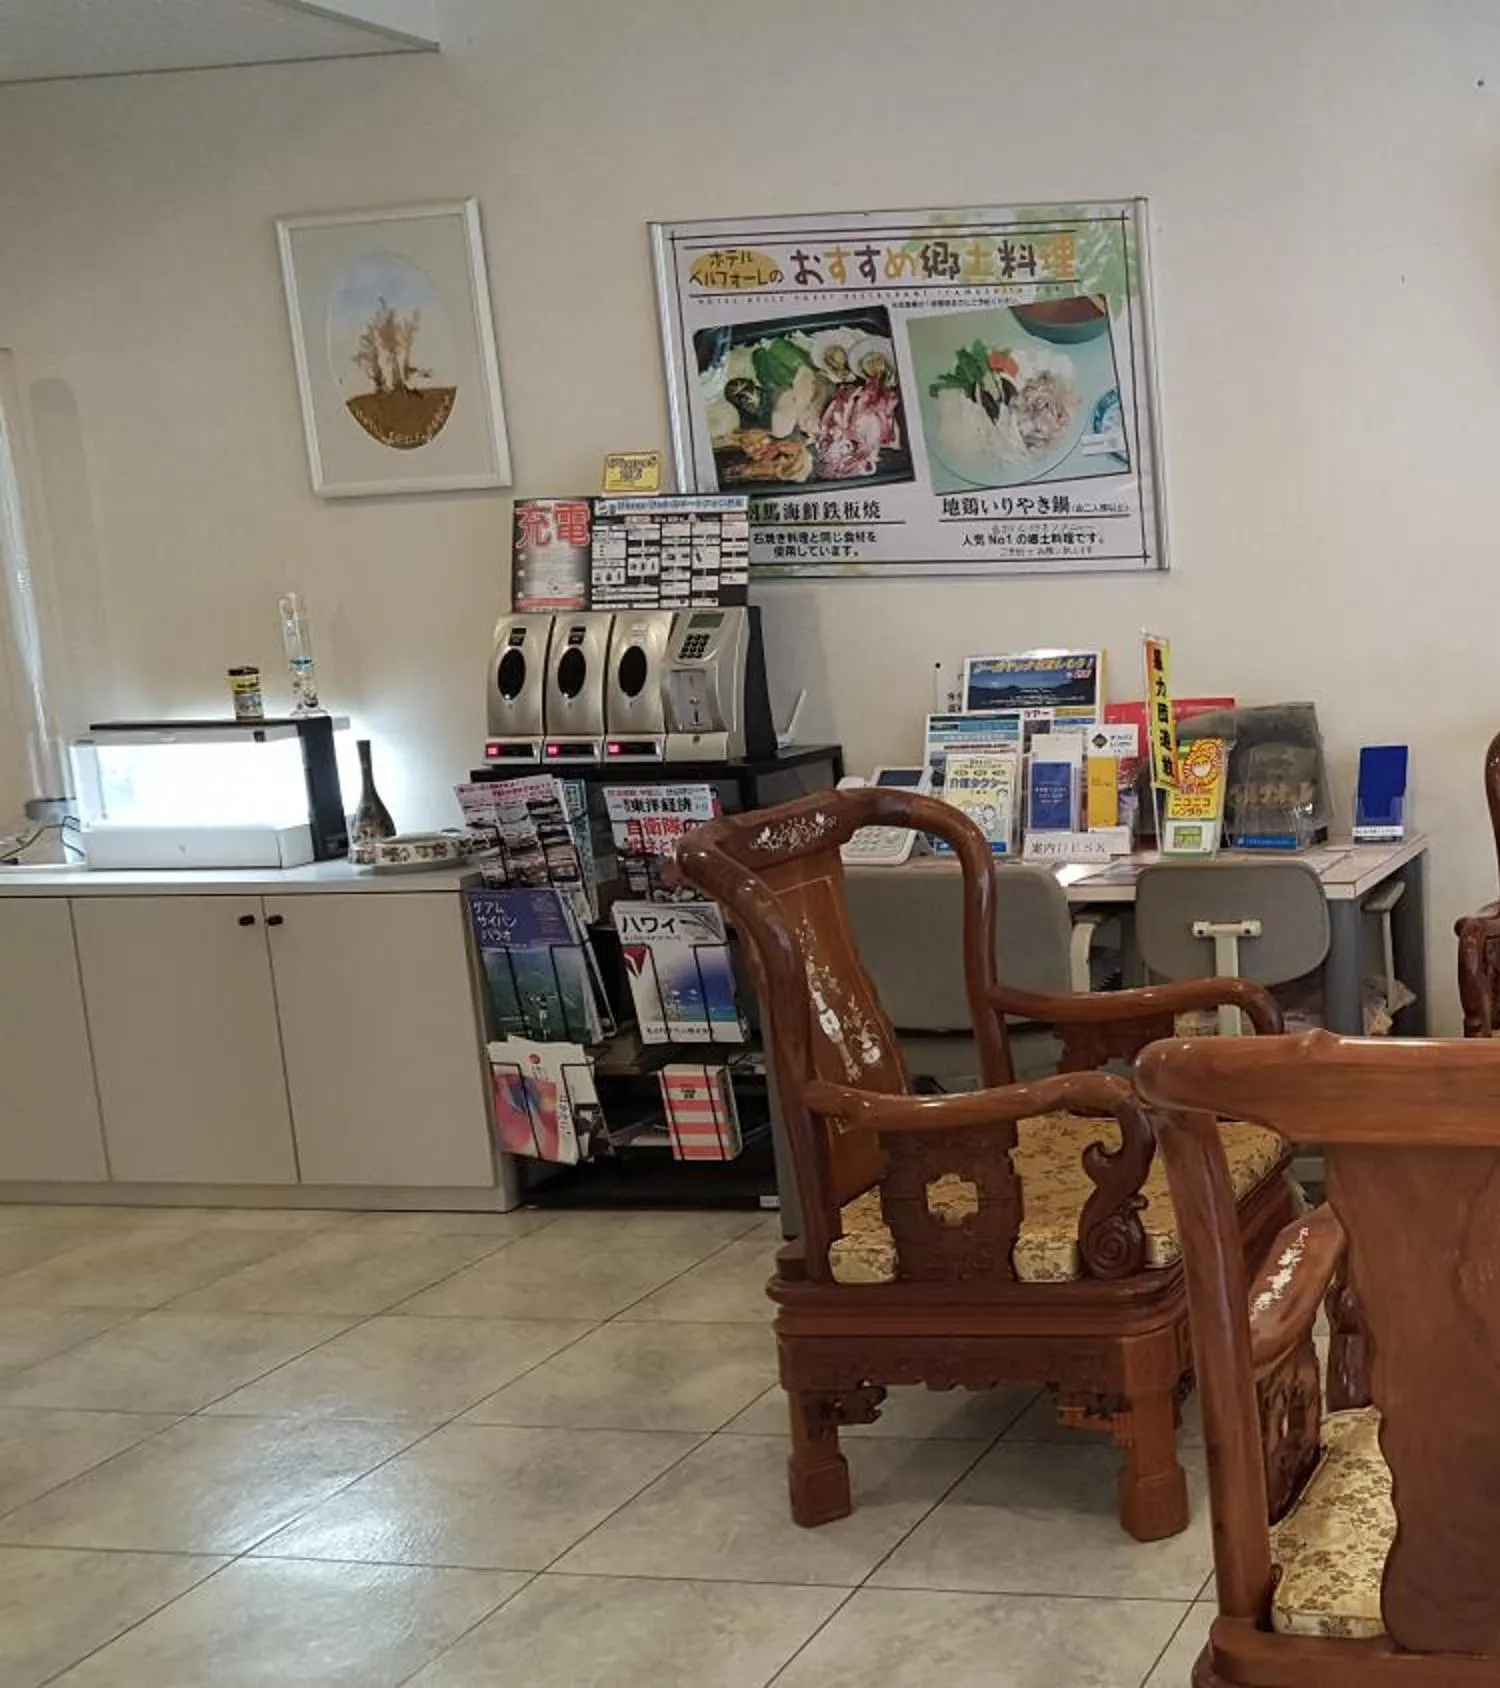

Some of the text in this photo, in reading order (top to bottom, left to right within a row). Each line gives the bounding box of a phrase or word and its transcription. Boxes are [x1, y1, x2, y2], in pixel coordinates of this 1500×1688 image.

[708, 250, 754, 268] ホテル
[789, 233, 1077, 287] おすすめ郷土料理
[943, 495, 1070, 516] 地鶏いりやき鍋
[515, 501, 591, 548] 充電
[753, 532, 877, 545] 石焼き料理と同じ食材を
[773, 546, 860, 558] 使用しています。
[1172, 797, 1211, 807] ニコニコ
[622, 916, 676, 934] ハワイ
